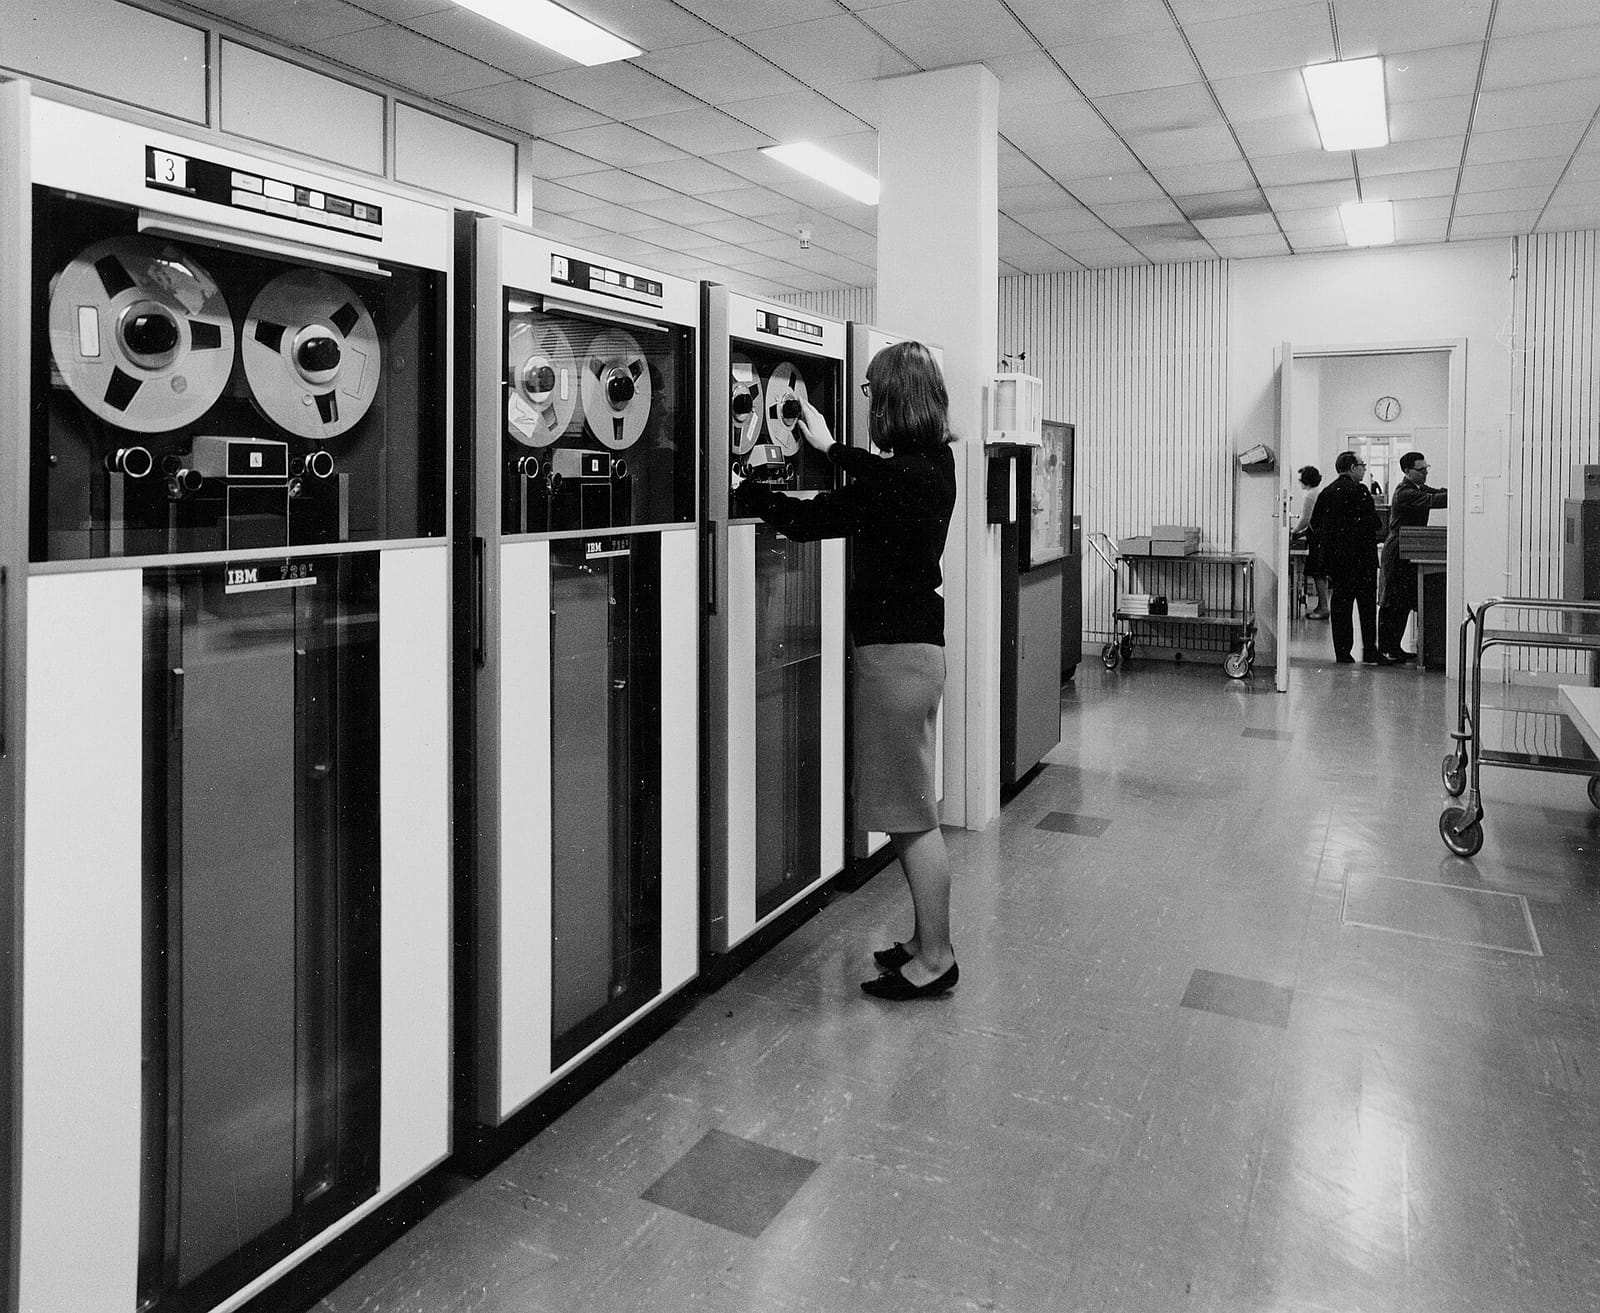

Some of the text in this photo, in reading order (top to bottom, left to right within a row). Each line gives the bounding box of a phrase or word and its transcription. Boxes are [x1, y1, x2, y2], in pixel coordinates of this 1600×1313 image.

[165, 159, 175, 181] 3
[588, 542, 602, 552] IBM
[228, 568, 257, 584] IBM
